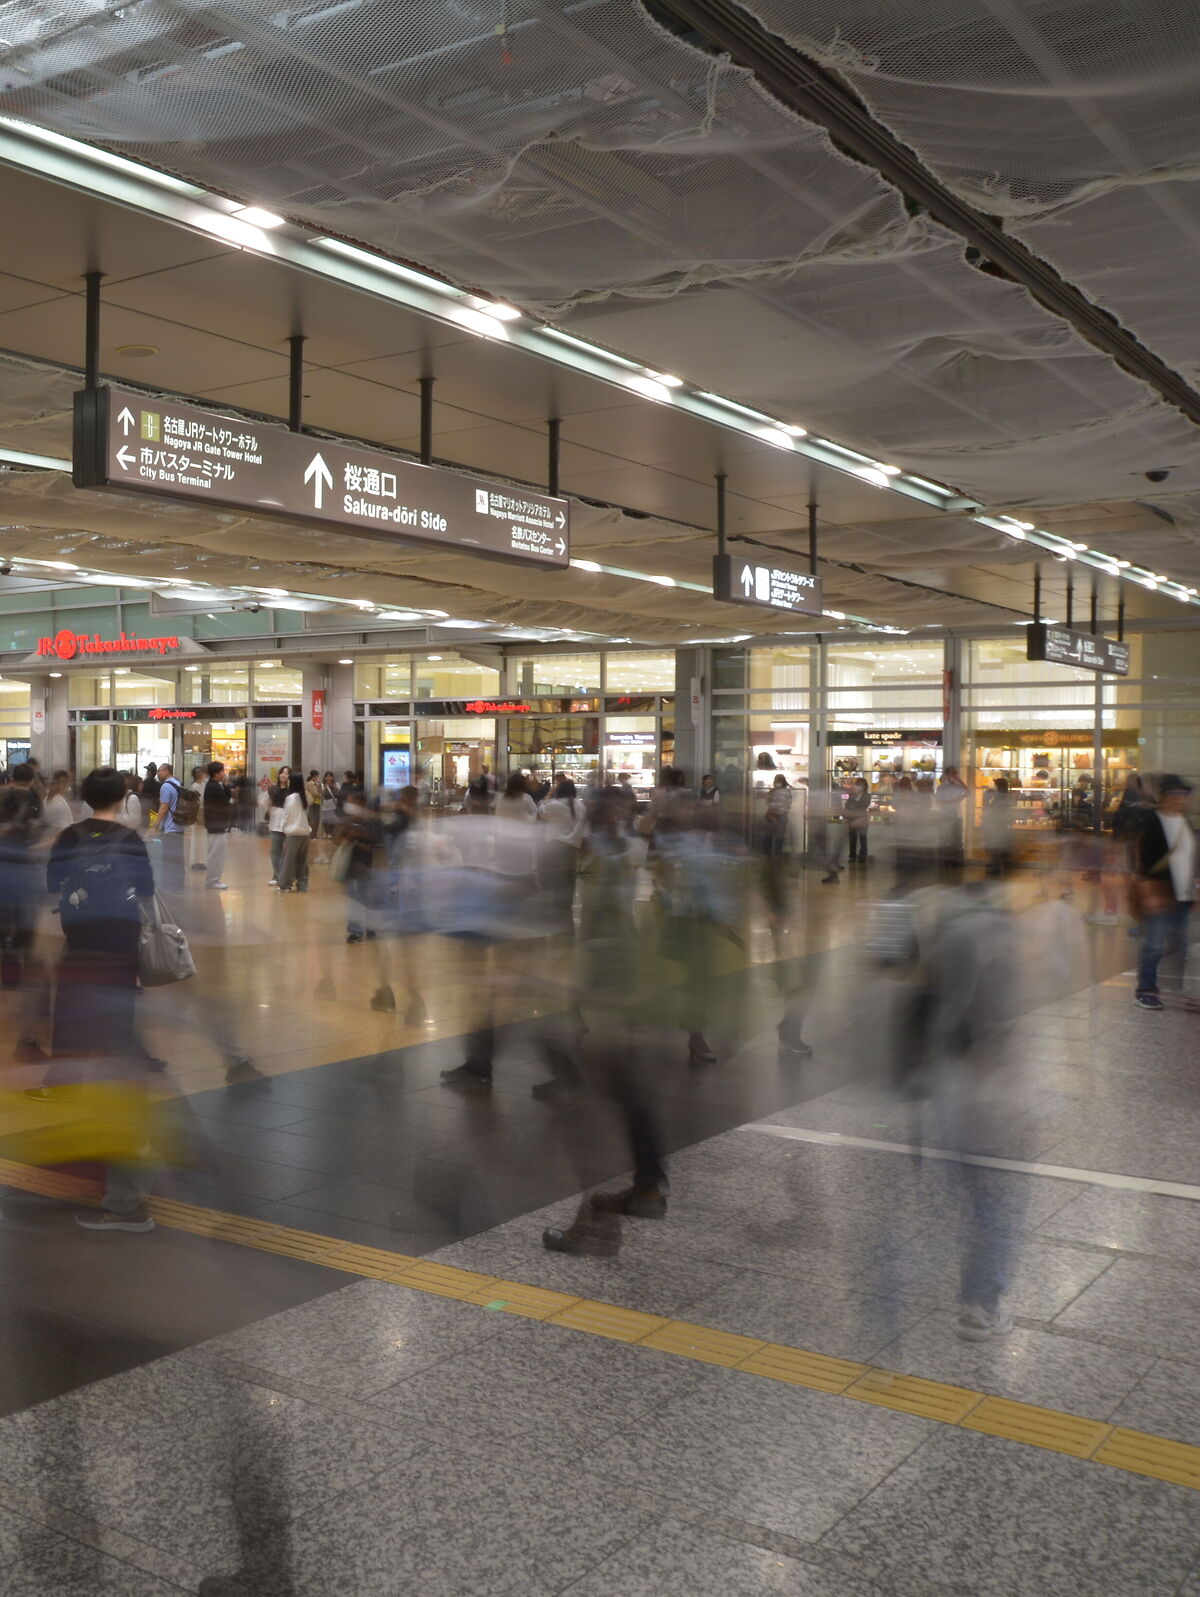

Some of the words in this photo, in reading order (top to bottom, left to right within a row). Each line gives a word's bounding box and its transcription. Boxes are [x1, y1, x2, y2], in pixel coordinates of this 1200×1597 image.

[163, 415, 258, 452] 名古屋JRゲートタワーホテル
[140, 447, 235, 481] 市バスターミナル
[164, 434, 191, 449] Nagoya
[193, 441, 203, 452] JR
[205, 443, 221, 456] Gate
[222, 447, 243, 461] Tower
[244, 452, 263, 465] Hotel
[140, 465, 157, 480] City
[159, 469, 175, 482] Bus
[177, 473, 211, 488] Terminal
[344, 462, 397, 499] 桜通口
[343, 494, 418, 526] Sakura-dōri
[420, 510, 447, 532] Side
[511, 525, 552, 544] 名鉄バスセンター
[75, 631, 179, 655] Takashimaya
[881, 732, 902, 740] spade
